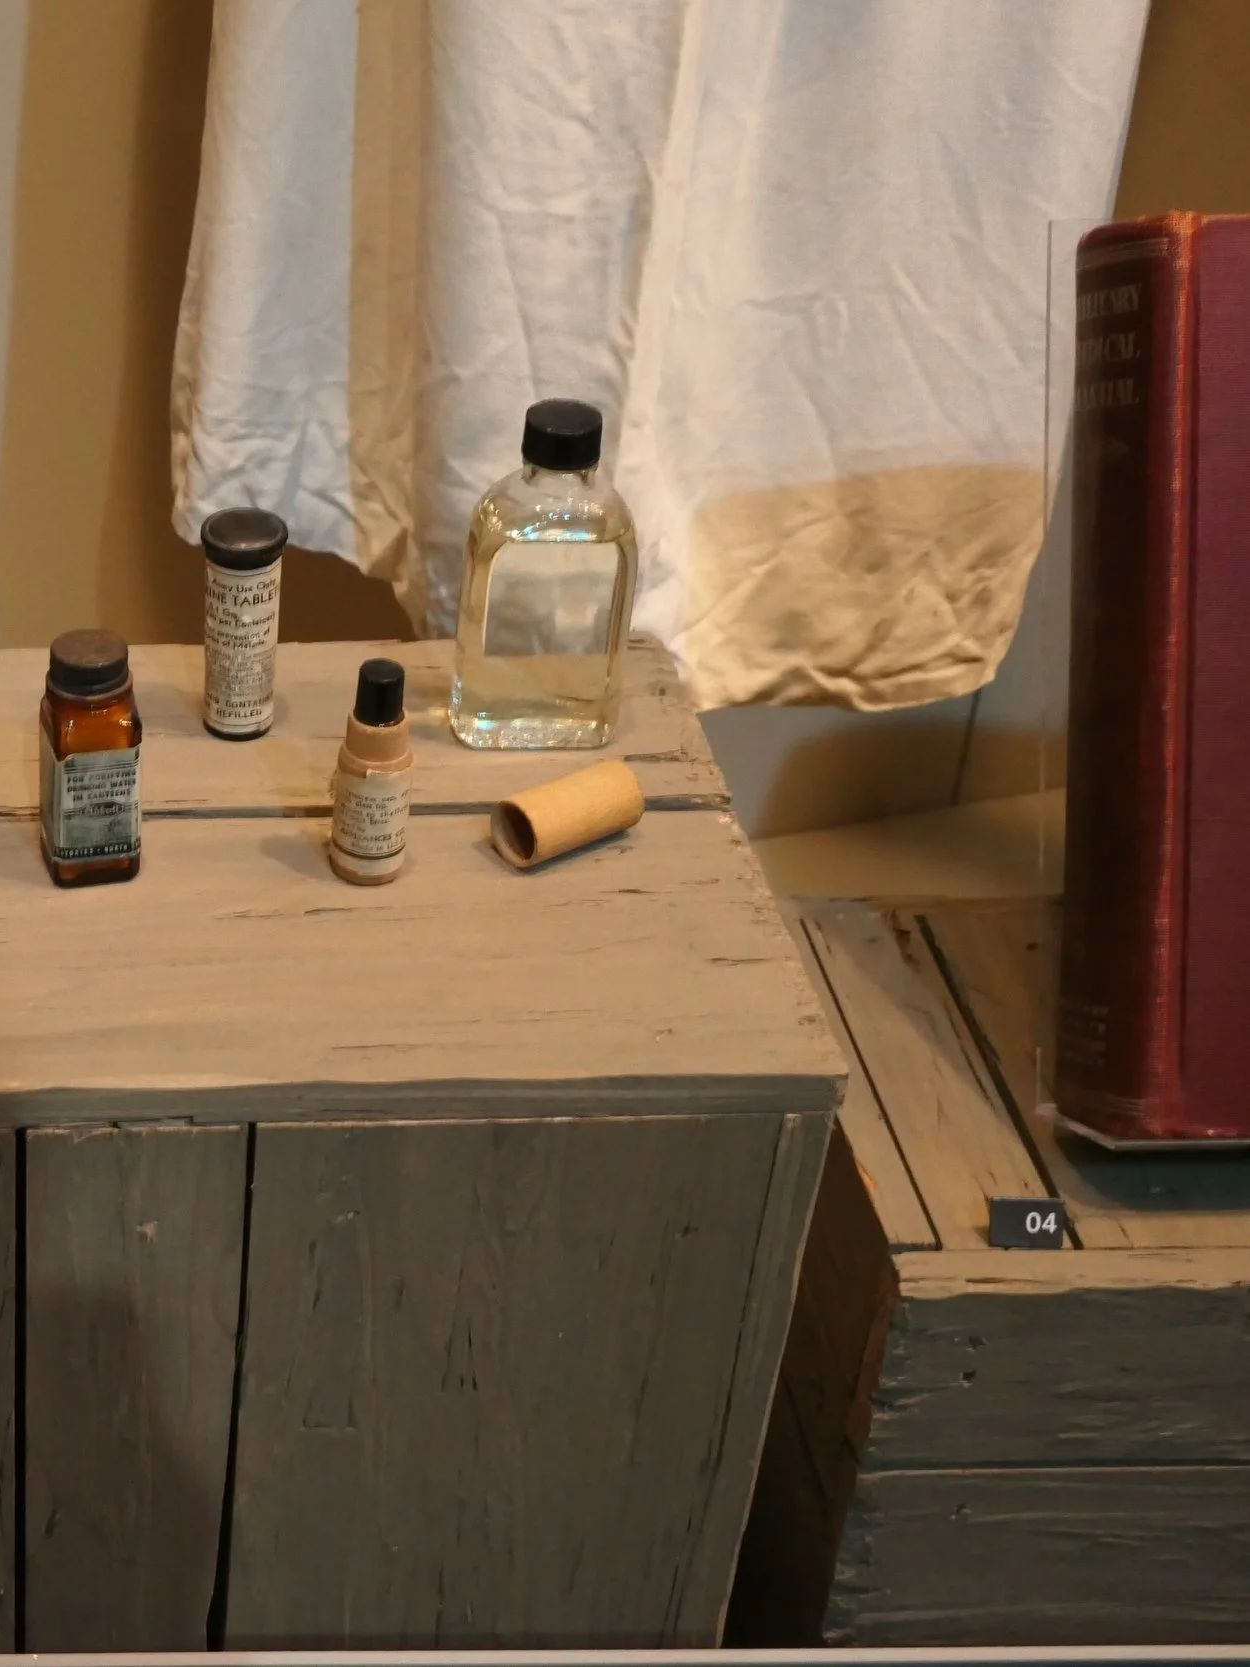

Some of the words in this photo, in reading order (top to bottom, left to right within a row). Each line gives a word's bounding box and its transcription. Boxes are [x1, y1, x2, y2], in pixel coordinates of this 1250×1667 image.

[236, 584, 253, 593] Use
[256, 578, 277, 591] Only
[67, 774, 85, 784] FOR
[109, 778, 136, 789] WATER
[1025, 1211, 1058, 1235] 04
